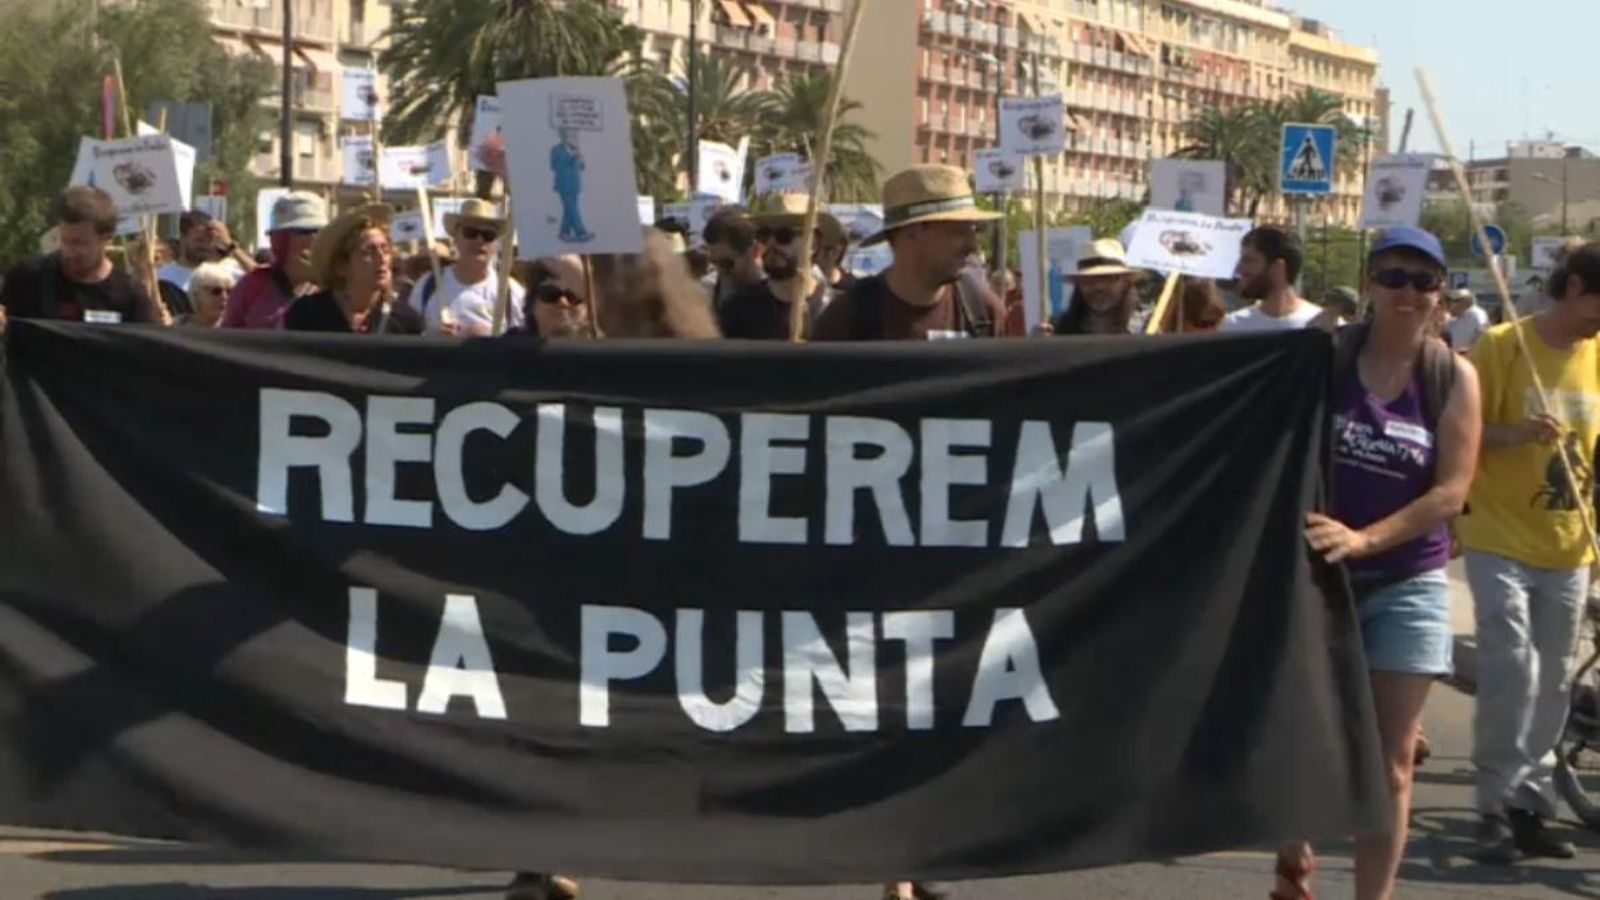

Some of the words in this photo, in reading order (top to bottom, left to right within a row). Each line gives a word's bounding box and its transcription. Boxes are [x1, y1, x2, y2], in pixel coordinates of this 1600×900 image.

[255, 389, 1125, 548] RECUPEREM
[344, 587, 508, 721] LA
[578, 606, 1061, 733] PUNTA
